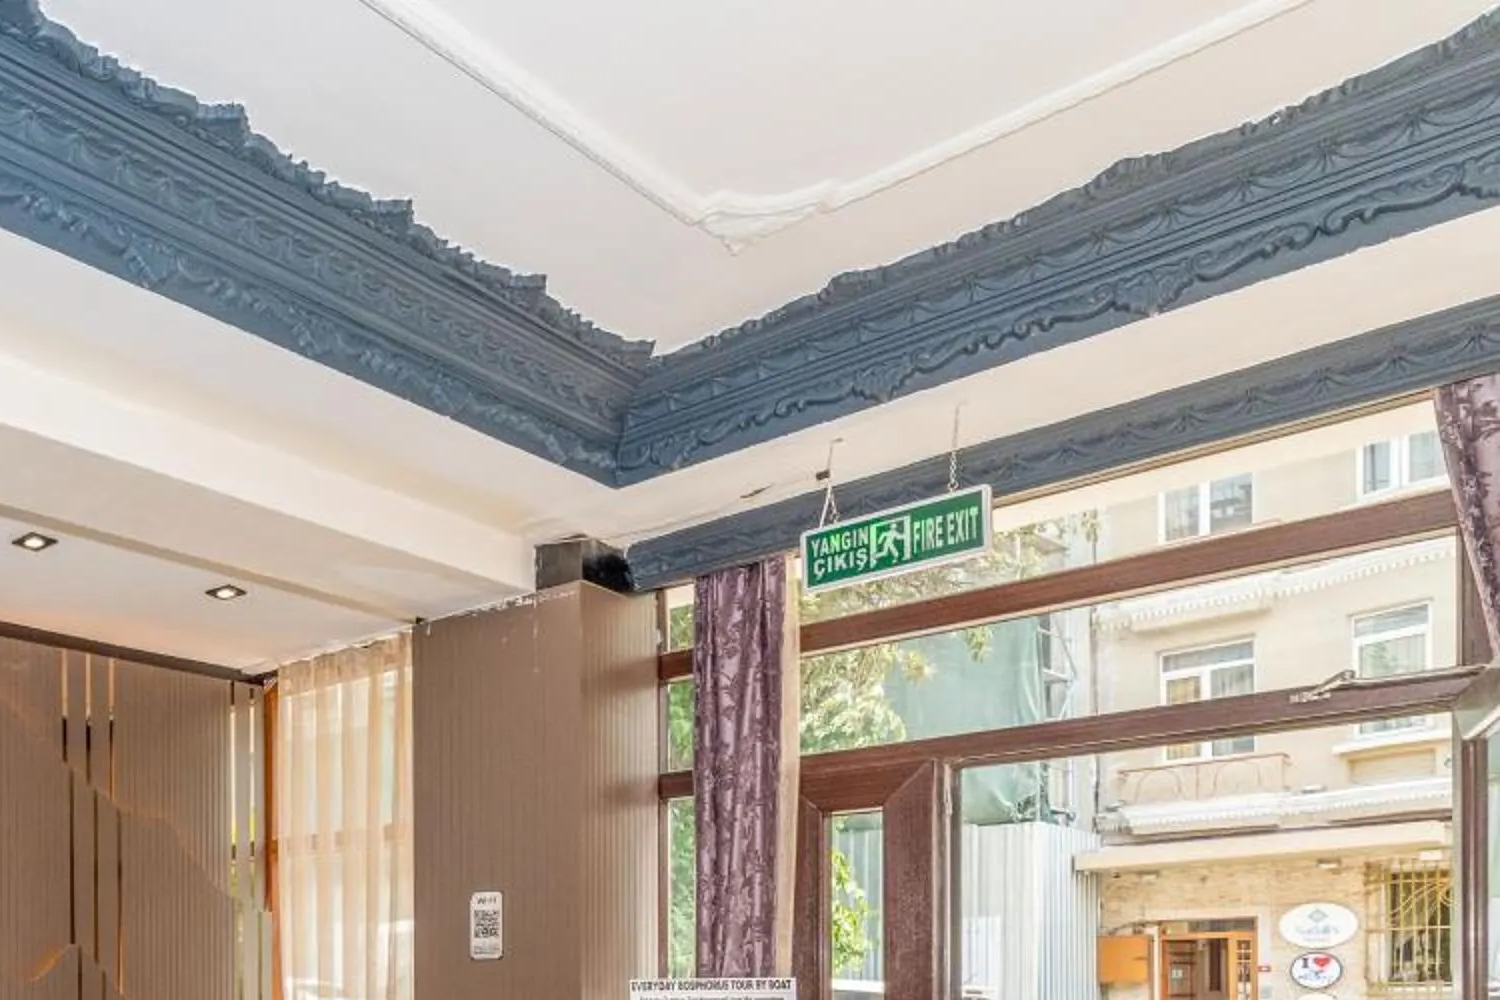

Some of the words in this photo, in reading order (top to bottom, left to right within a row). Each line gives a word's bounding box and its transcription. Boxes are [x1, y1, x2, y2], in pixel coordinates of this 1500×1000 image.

[810, 525, 869, 558] YANGIN
[913, 517, 944, 555] FIRE
[946, 506, 979, 545] EXIT
[813, 548, 869, 580] ÇIKIŞ
[631, 980, 676, 992] EVERYDAY
[678, 980, 729, 991] BOSPHORUS
[731, 979, 754, 990] TOUR
[755, 979, 767, 990] BY
[769, 979, 791, 990] BOAT
